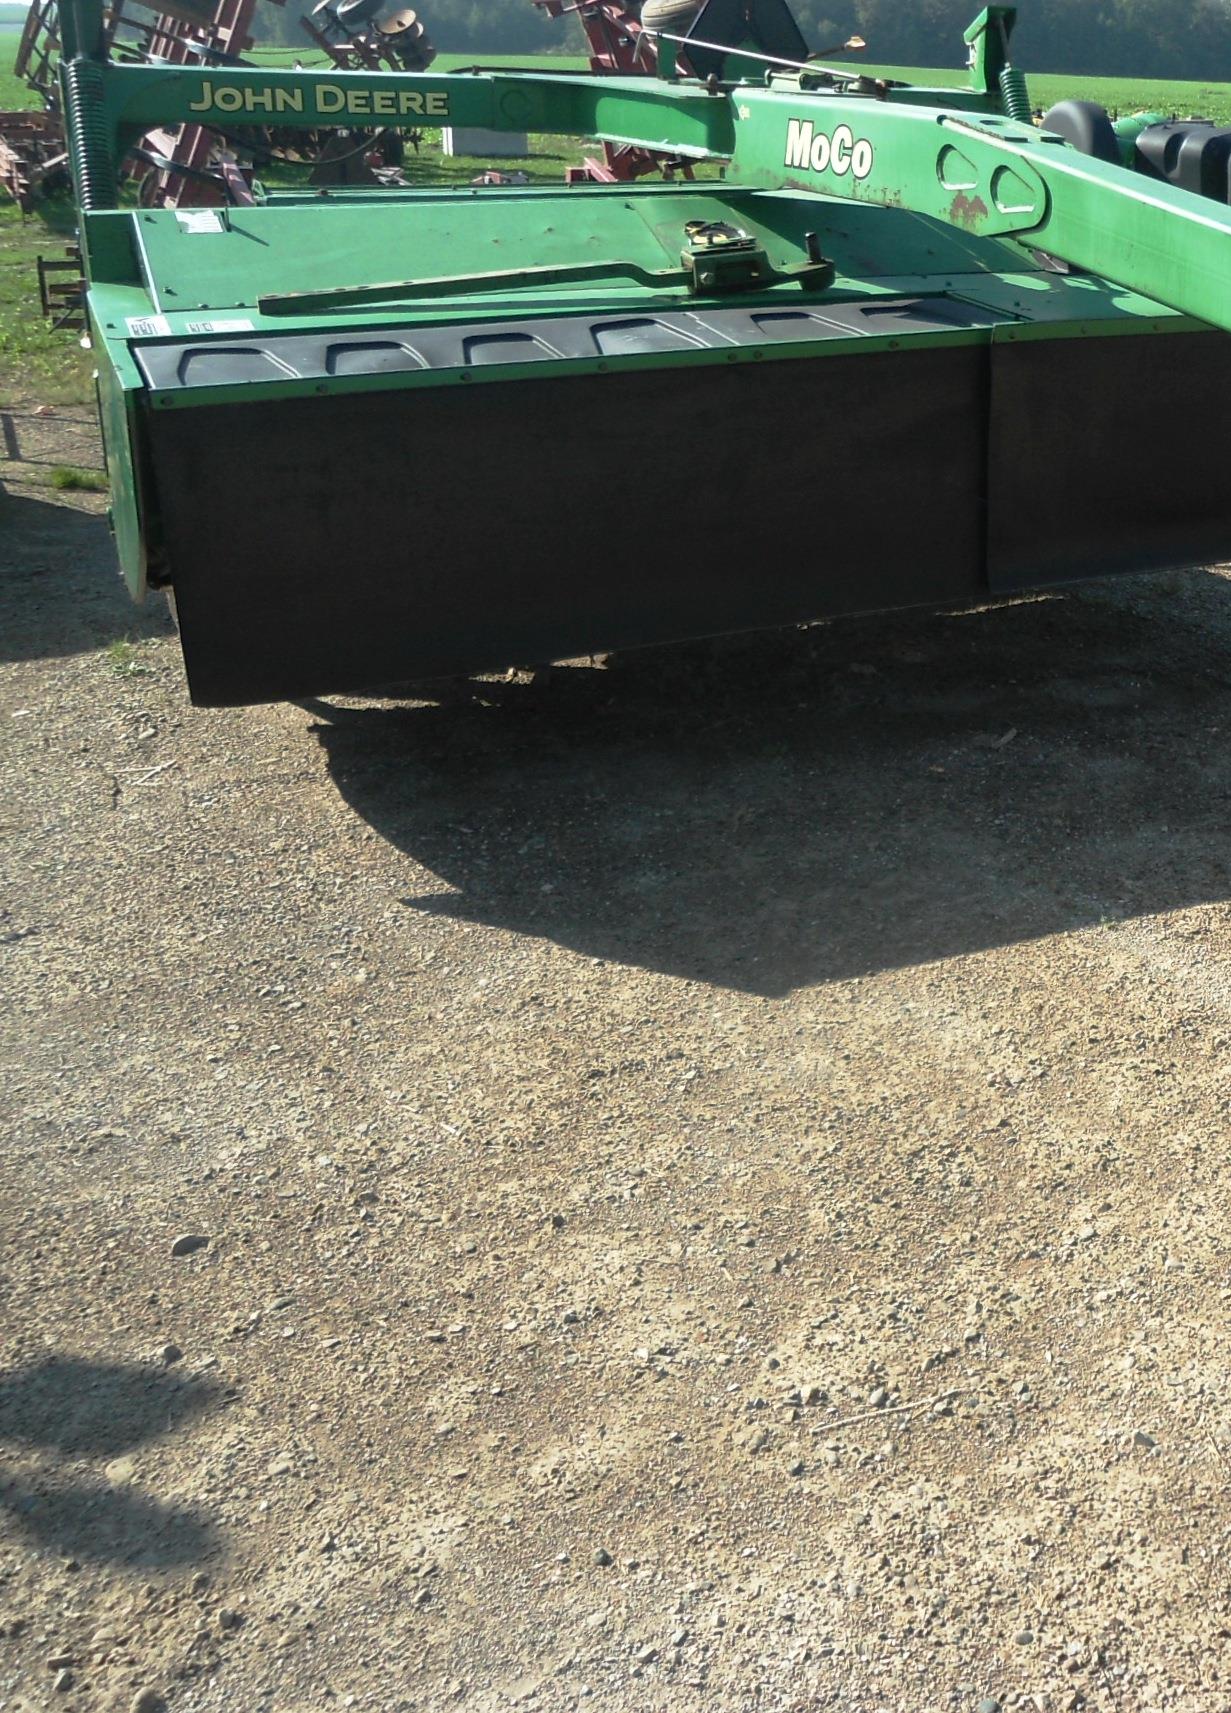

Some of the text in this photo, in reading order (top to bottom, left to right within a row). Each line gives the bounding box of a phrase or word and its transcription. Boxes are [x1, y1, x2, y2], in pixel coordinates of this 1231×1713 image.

[190, 82, 449, 116] JOHN DEERE
[784, 118, 873, 180] MoCo
